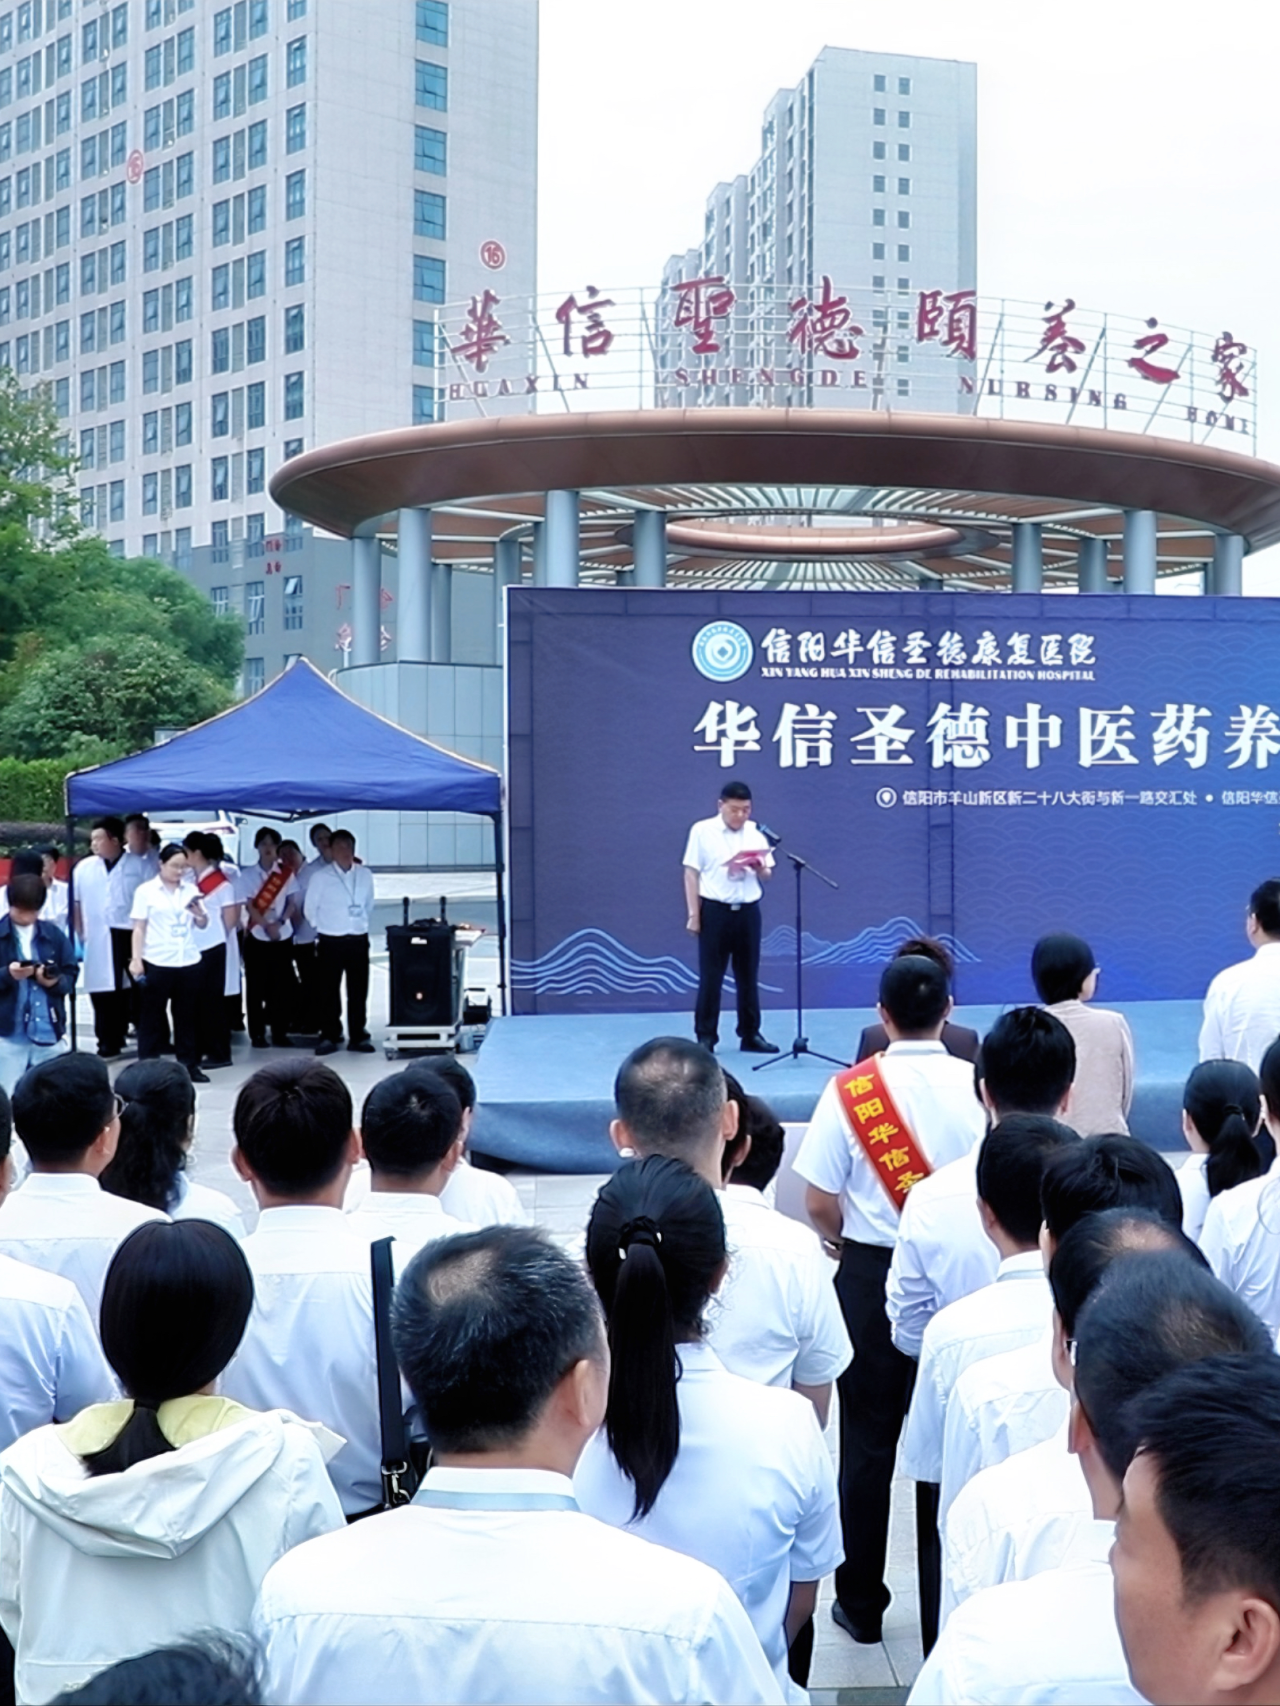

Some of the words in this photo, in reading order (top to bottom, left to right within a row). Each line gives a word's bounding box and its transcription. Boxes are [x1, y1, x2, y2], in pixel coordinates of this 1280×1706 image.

[450, 373, 591, 400] HUAXIN
[675, 367, 868, 387] SHENGDE
[959, 375, 1129, 410] NURSING
[1186, 405, 1251, 434] HOME
[760, 628, 1096, 667] 信阳华信圣德康复医院
[761, 667, 783, 678] XIN
[785, 667, 818, 678] YANG
[820, 667, 847, 678] HUA
[848, 668, 871, 679] XIN
[872, 668, 913, 679] SHENG
[934, 669, 1035, 680] REHABILITATION
[1037, 670, 1096, 681] HOSPITAL
[902, 789, 1198, 806] 信阳市羊山新区新二十八大街与新一路交汇处
